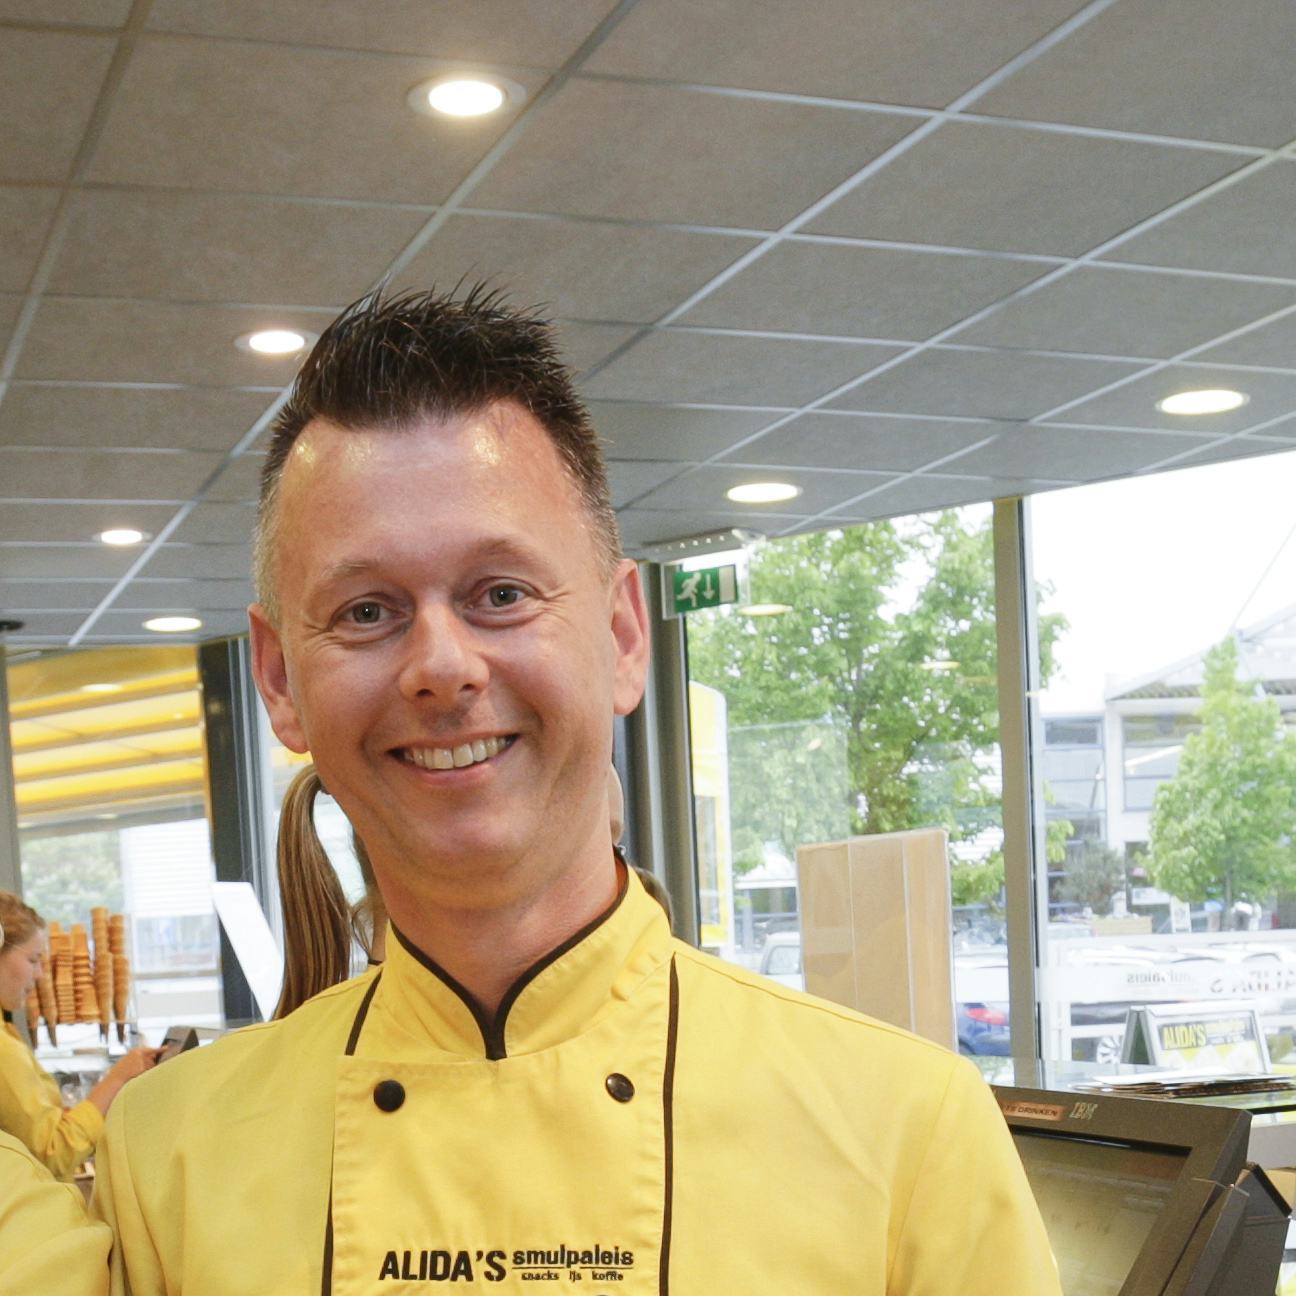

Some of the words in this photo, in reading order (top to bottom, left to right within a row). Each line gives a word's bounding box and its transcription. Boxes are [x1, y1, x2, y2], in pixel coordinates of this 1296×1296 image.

[1163, 1022, 1207, 1050] ALIDA'S
[1069, 1102, 1098, 1120] IBM
[379, 1250, 507, 1282] ALIDA'S
[512, 1244, 634, 1268] smulpaleis
[521, 1270, 559, 1281] snacks
[592, 1270, 624, 1281] koffie
